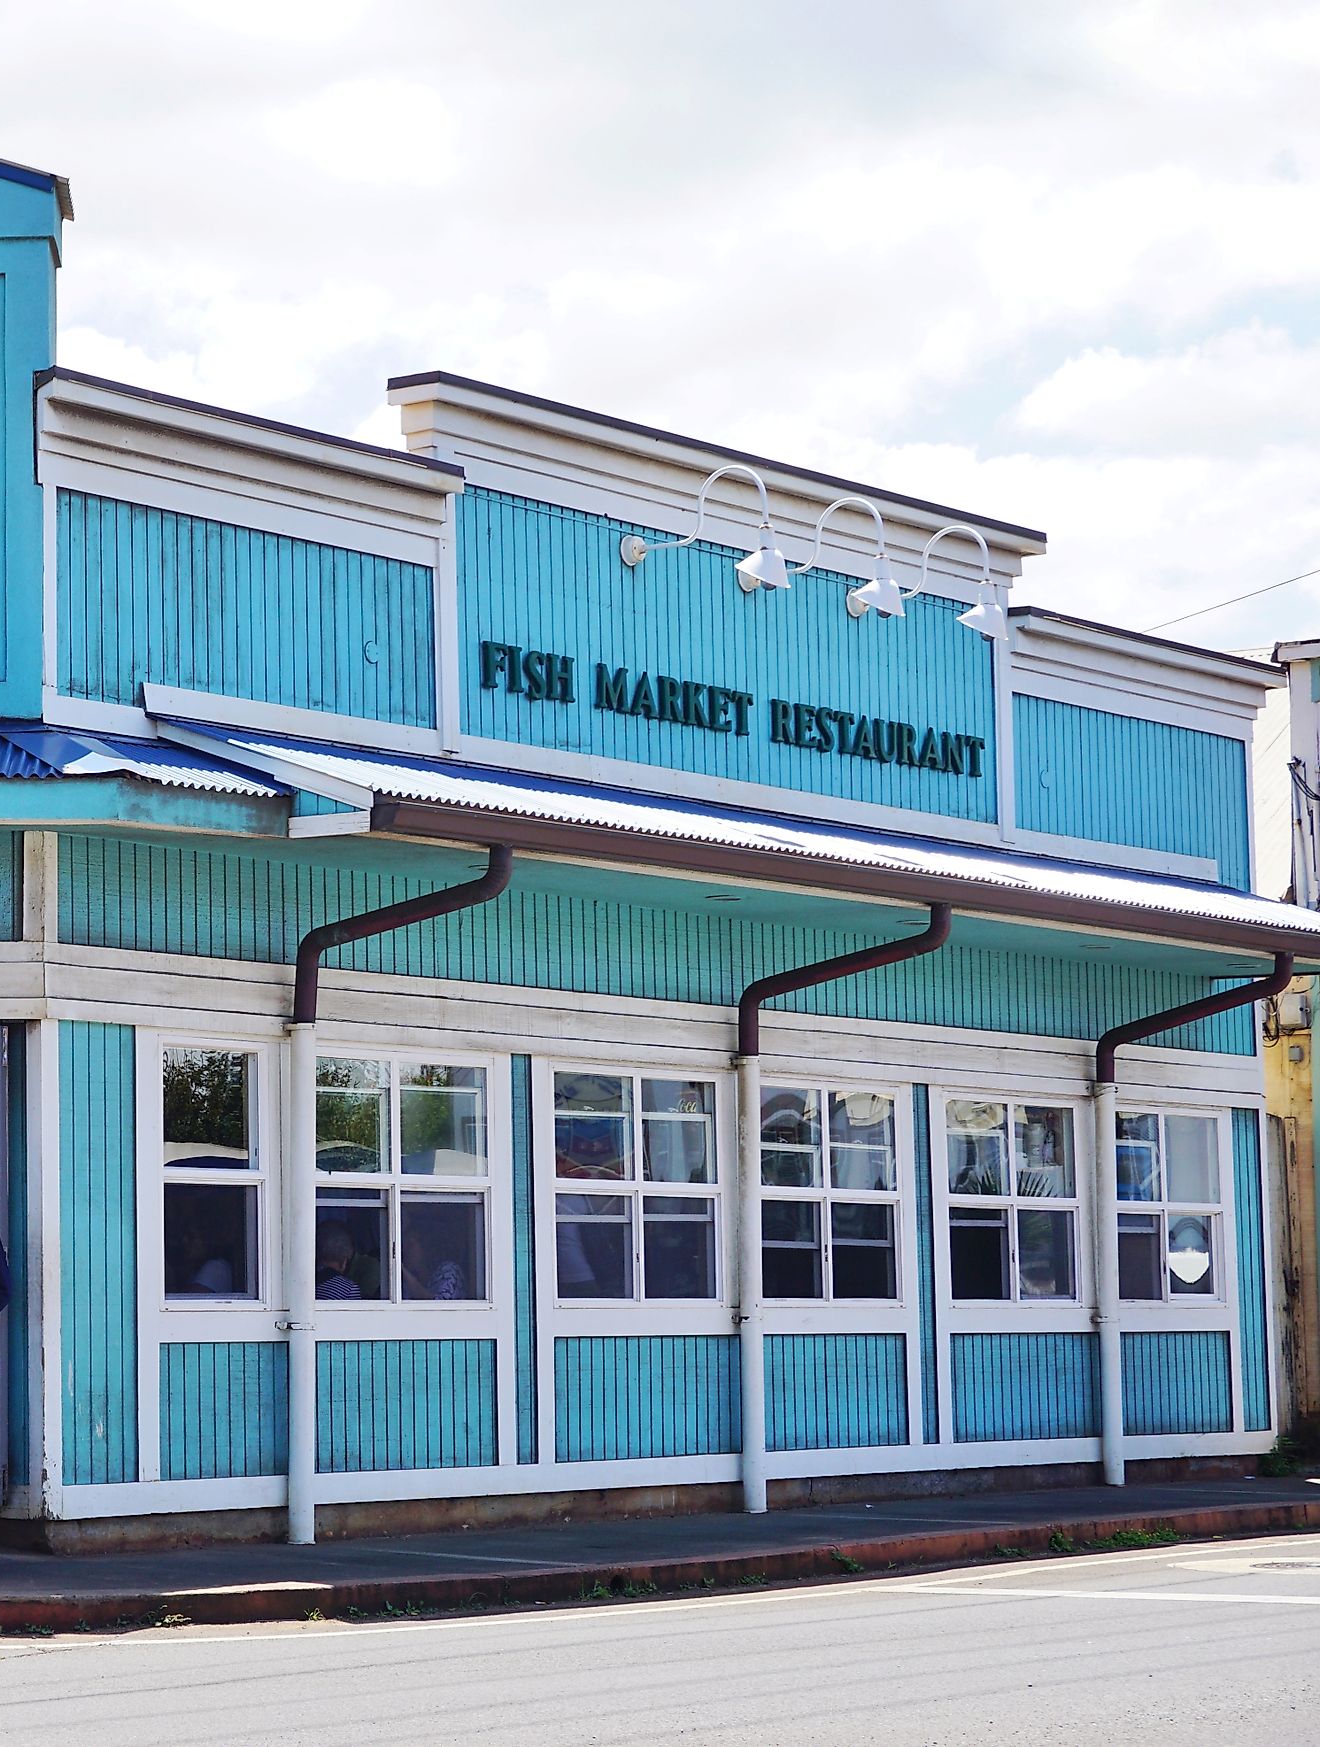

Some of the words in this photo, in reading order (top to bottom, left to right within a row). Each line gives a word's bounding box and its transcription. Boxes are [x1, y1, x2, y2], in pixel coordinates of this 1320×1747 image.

[480, 640, 577, 704] FISH
[594, 662, 754, 737] MARKET
[769, 698, 986, 778] RESTAURANT
